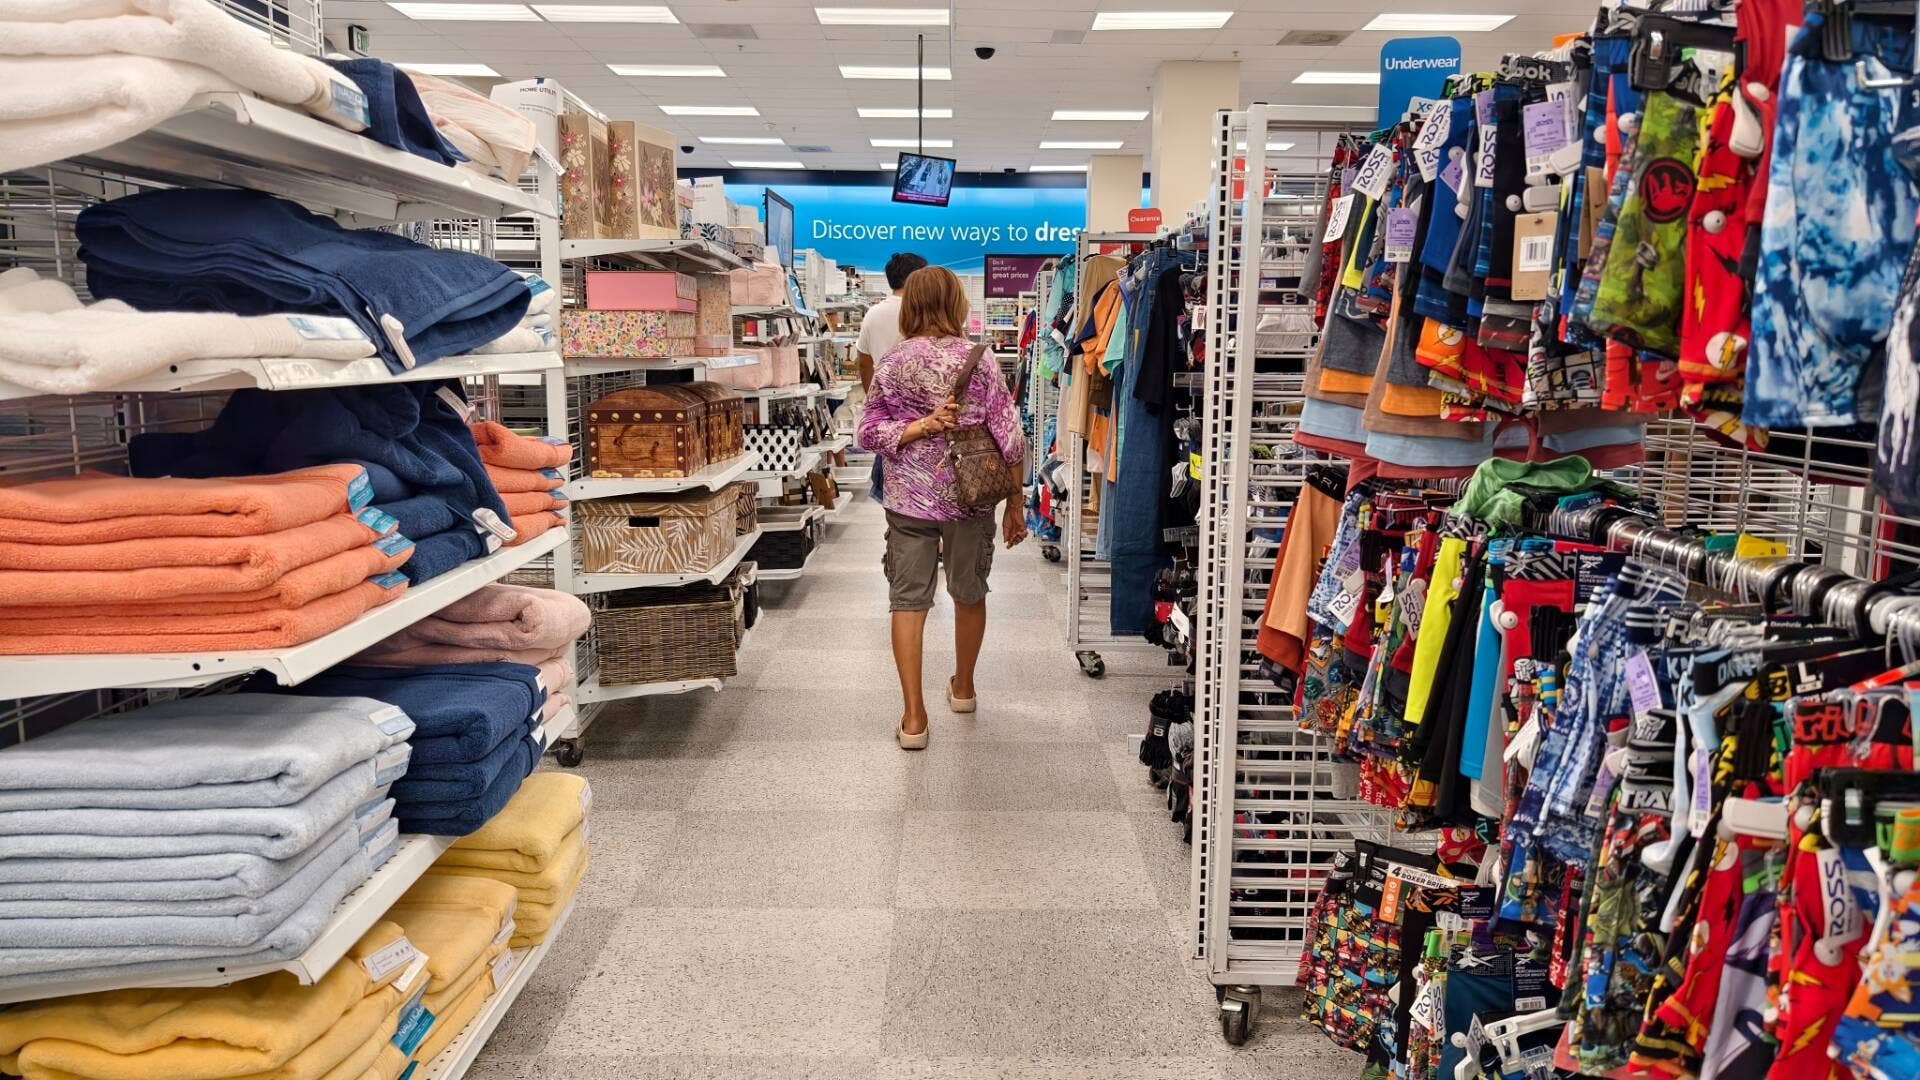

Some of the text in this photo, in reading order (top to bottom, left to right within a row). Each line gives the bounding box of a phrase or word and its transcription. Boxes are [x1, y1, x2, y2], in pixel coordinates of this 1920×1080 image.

[1384, 56, 1459, 71] Underwear
[1421, 104, 1450, 145] ROSS
[1357, 149, 1386, 189] ROSS
[1420, 147, 1440, 165] RO
[1480, 130, 1497, 180] ROSS
[812, 219, 1088, 247] Discover new ways to dres
[992, 272, 1010, 280] great
[1391, 866, 1402, 877] 4
[1401, 873, 1426, 884] BOXER
[1426, 878, 1449, 889] BRIEF
[1824, 858, 1846, 938] ROSS
[1432, 985, 1444, 1033] ROSS
